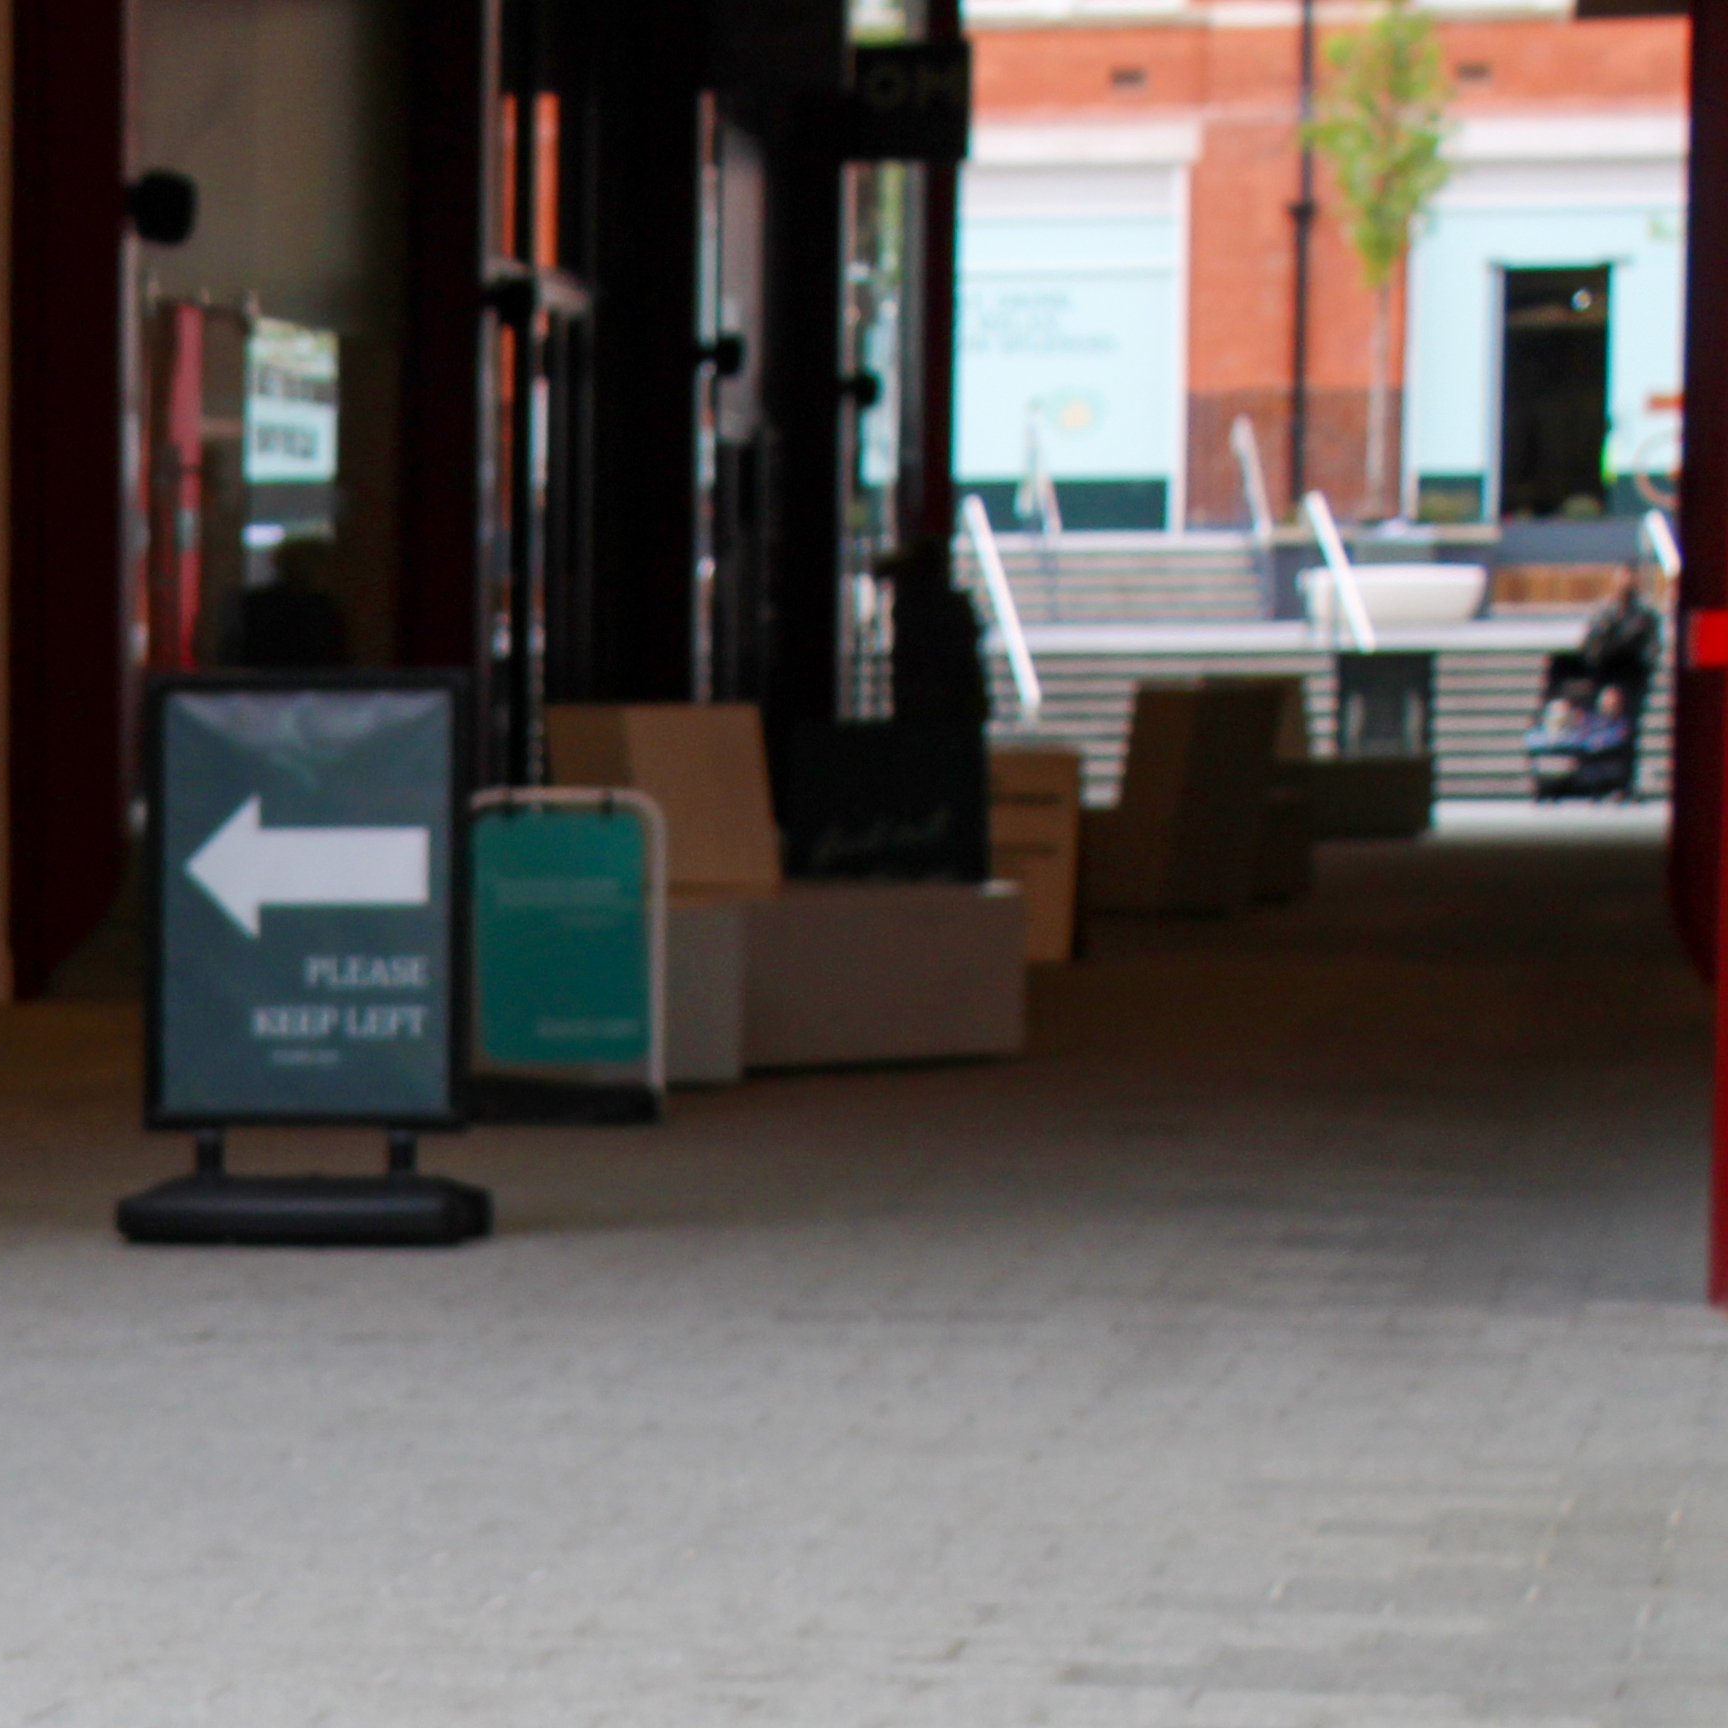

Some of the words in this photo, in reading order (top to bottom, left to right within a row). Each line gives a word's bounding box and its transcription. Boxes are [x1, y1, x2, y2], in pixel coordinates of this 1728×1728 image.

[304, 955, 428, 987] PLEASE
[252, 1005, 338, 1037] KEEP
[345, 1005, 427, 1037] LEFT
